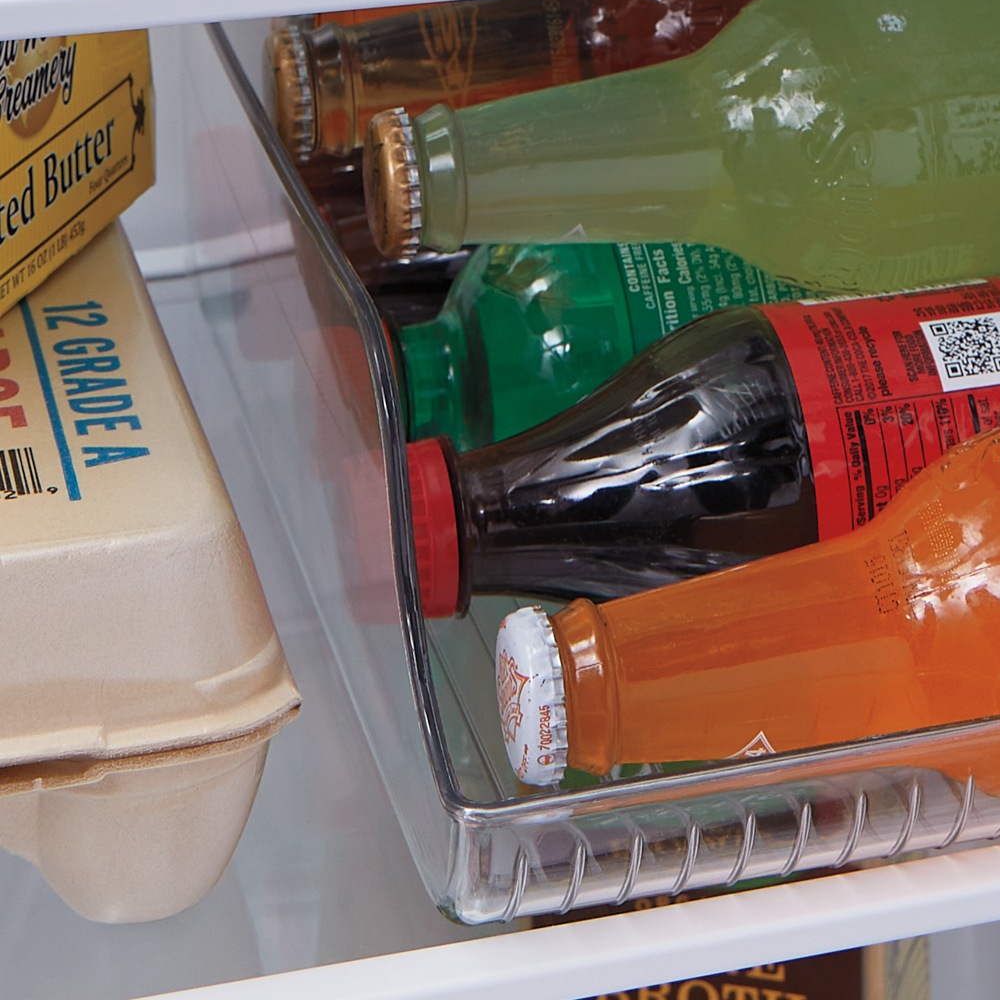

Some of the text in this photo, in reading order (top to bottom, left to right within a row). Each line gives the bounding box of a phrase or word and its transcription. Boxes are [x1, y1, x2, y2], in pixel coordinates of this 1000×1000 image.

[44, 117, 116, 208] Butter
[12, 267, 27, 291] WT
[26, 258, 37, 277] 16
[37, 248, 49, 270] OZ
[652, 248, 671, 284] Facts
[637, 262, 656, 310] CAFFEINE
[859, 326, 893, 397] please recycle
[905, 361, 919, 383] SCAN
[42, 300, 151, 468] 12 GRADE A
[844, 411, 857, 440] Value
[863, 408, 877, 426] 0%
[881, 405, 895, 424] 3%
[900, 402, 914, 427] 20%
[849, 441, 861, 468] Daily
